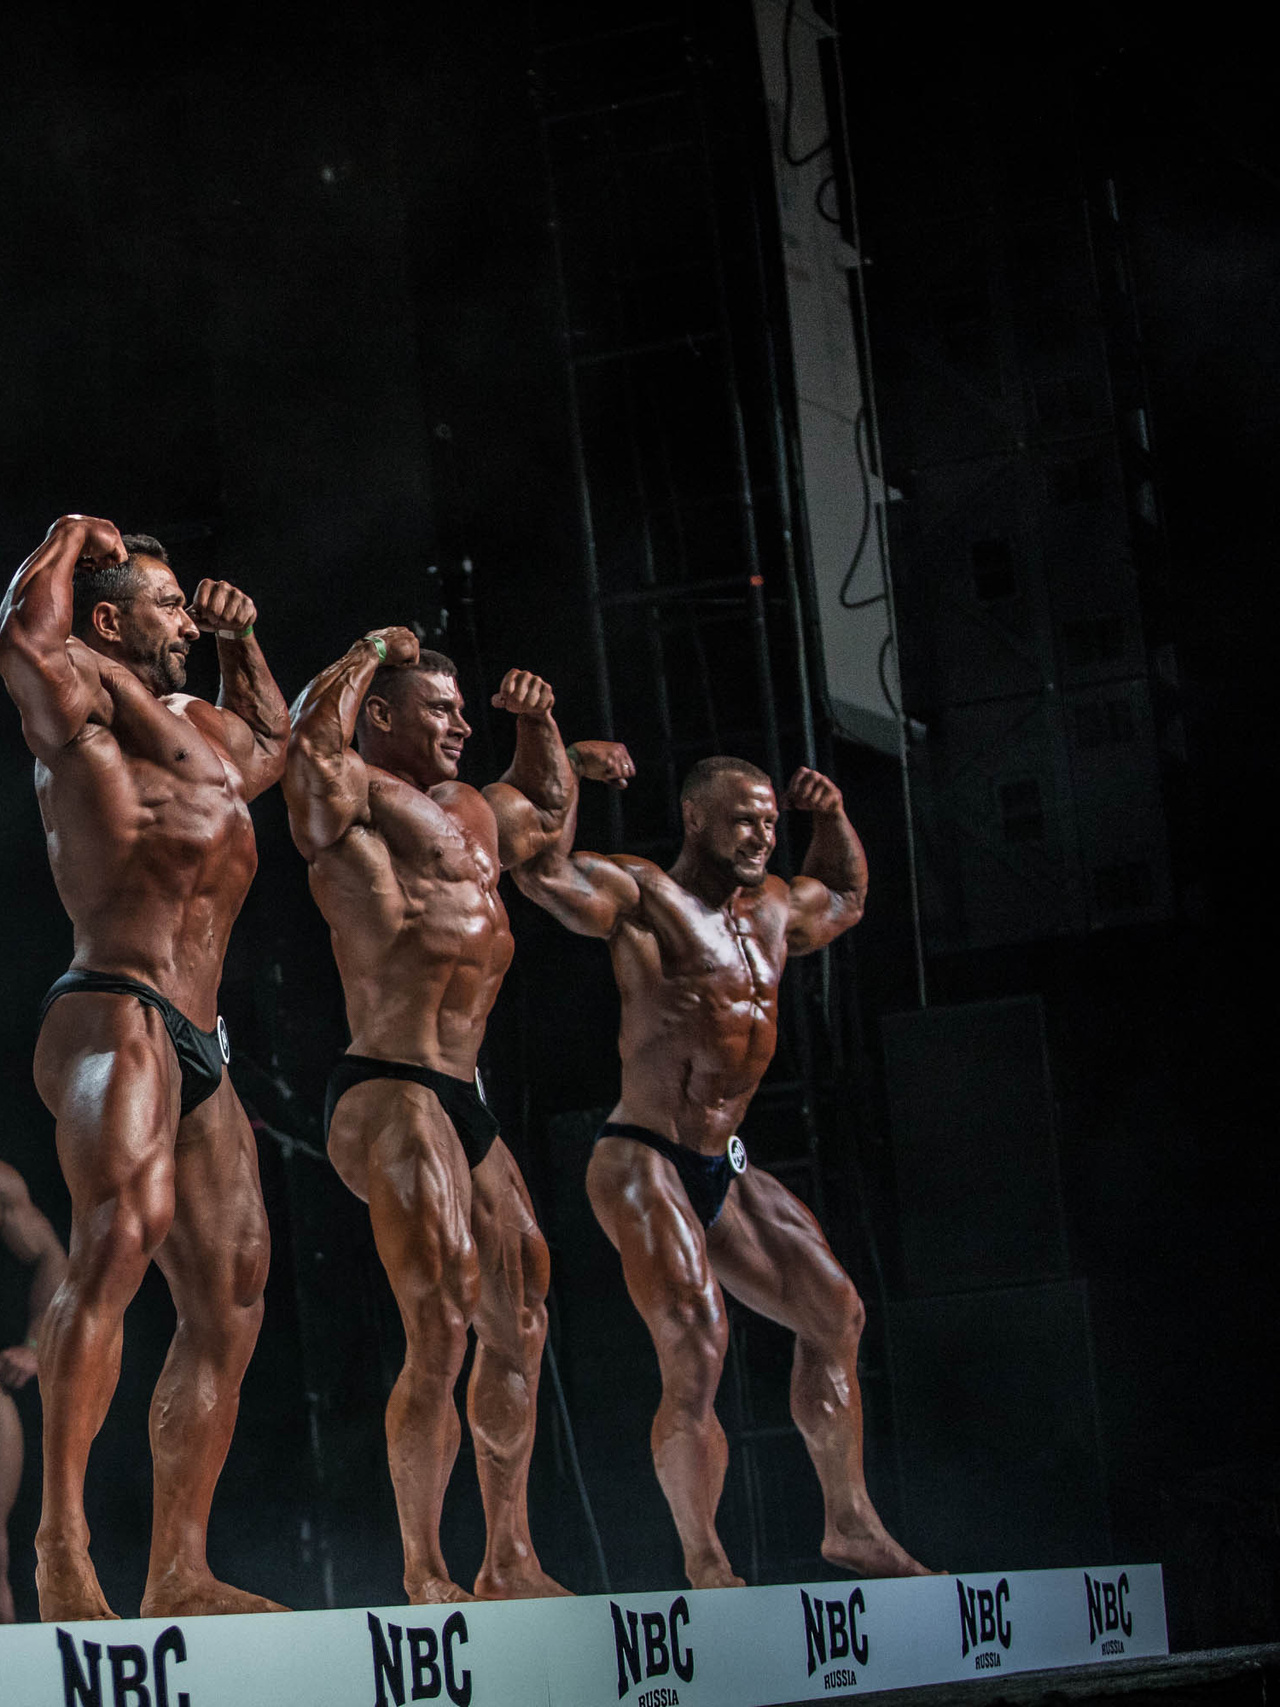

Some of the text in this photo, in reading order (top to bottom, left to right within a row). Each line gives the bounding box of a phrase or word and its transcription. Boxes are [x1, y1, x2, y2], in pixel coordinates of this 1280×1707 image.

[801, 1587, 869, 1678] NBC
[956, 1578, 1011, 1659] NBC
[1084, 1571, 1132, 1645] NBC
[56, 1625, 190, 1707] NBC
[367, 1611, 472, 1707] NBC
[610, 1596, 694, 1700] NBC
[824, 1669, 857, 1690] RUSSIA
[975, 1652, 1001, 1670] RUSSIA
[1102, 1640, 1125, 1656] RUSSIA
[638, 1688, 680, 1707] RUSSIA
